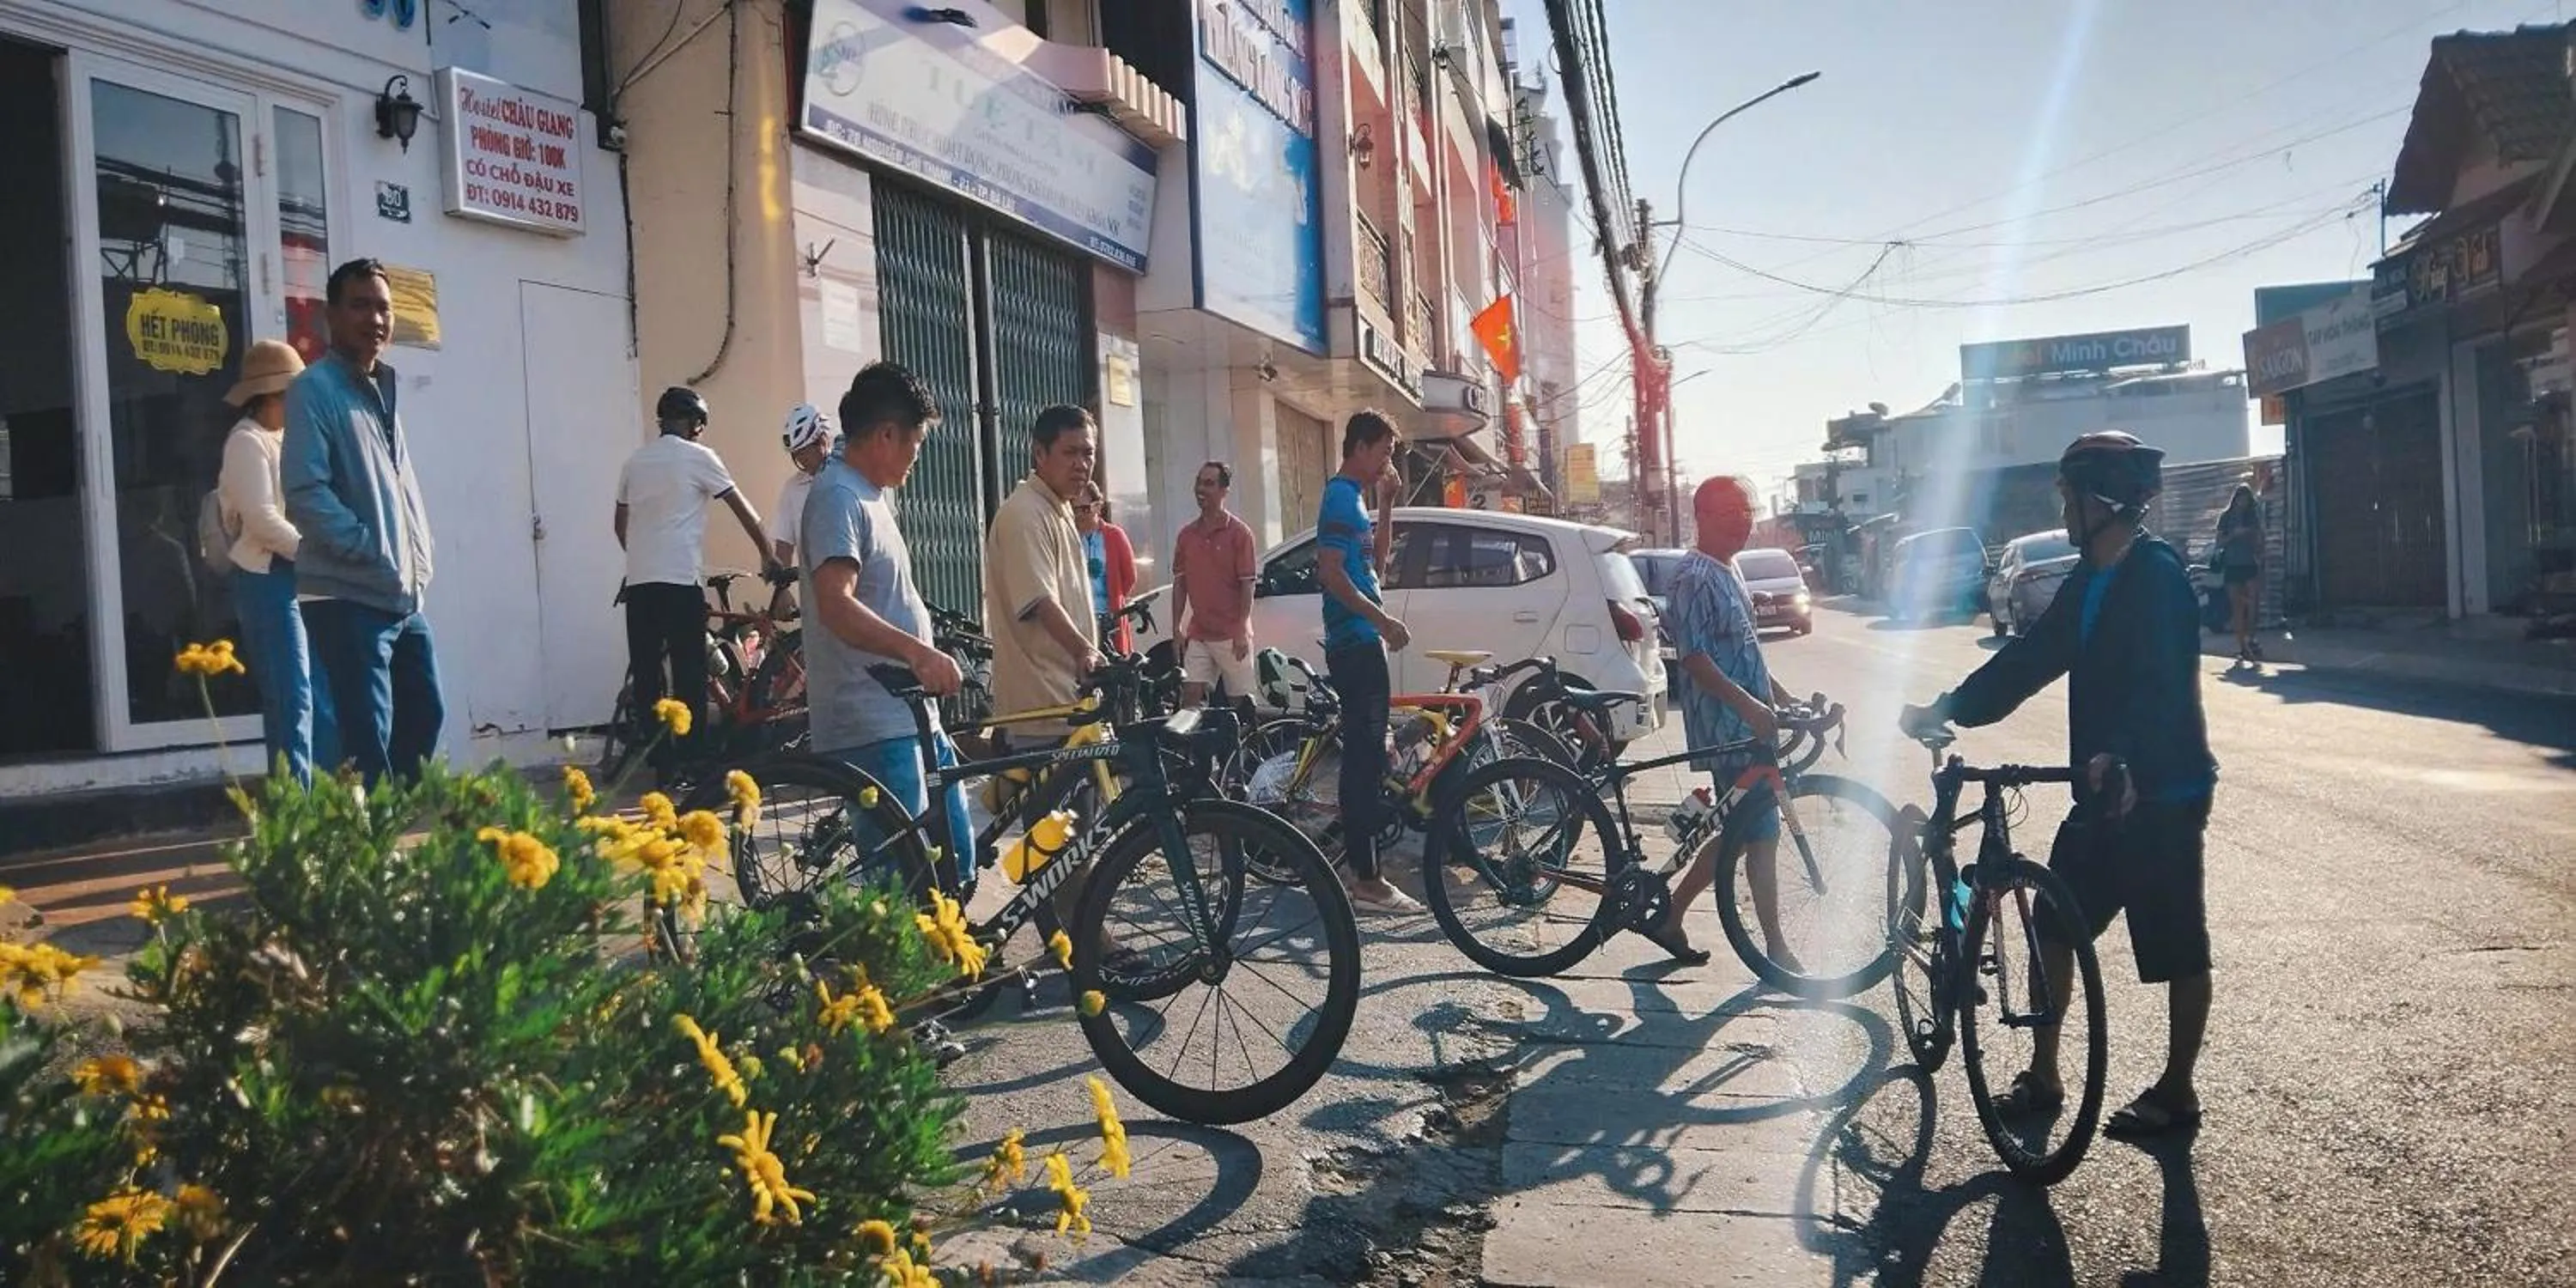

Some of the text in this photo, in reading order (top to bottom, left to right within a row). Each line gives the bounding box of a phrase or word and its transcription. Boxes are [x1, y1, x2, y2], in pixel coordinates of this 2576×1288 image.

[538, 109, 574, 139] GIANG
[471, 124, 510, 156] PHÒNG
[540, 143, 567, 170] 100K
[466, 158, 574, 197] CÓ CHỖ ĐẬU XE
[467, 184, 579, 222] ĐT: 0914 432 879
[172, 315, 219, 346] PHÒNG
[2051, 340, 2105, 362] Minh
[2113, 333, 2177, 357] Châu
[1001, 815, 1113, 933] S-WORKS
